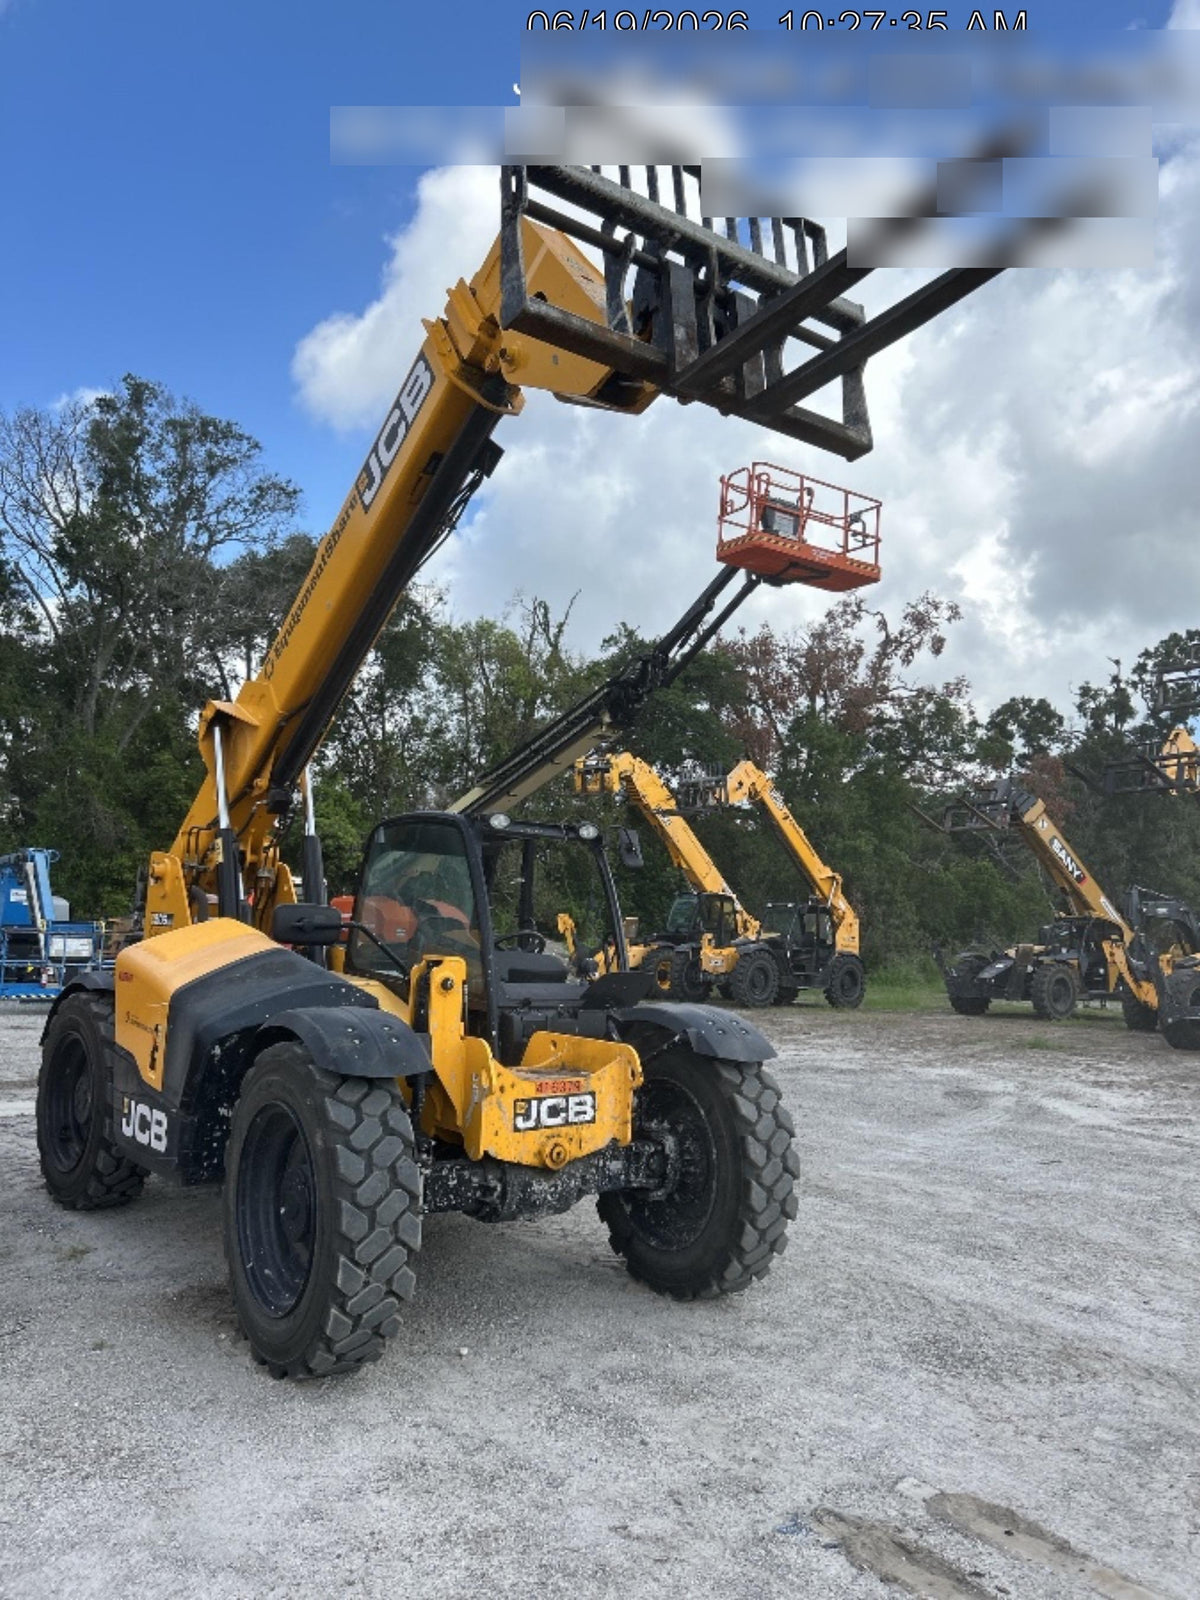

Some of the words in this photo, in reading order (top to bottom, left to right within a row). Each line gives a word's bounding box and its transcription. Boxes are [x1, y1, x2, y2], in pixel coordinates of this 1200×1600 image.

[360, 358, 434, 507] JCB
[1052, 837, 1082, 879] SANY
[121, 1099, 168, 1153] JCB
[515, 1094, 595, 1130] JCB
